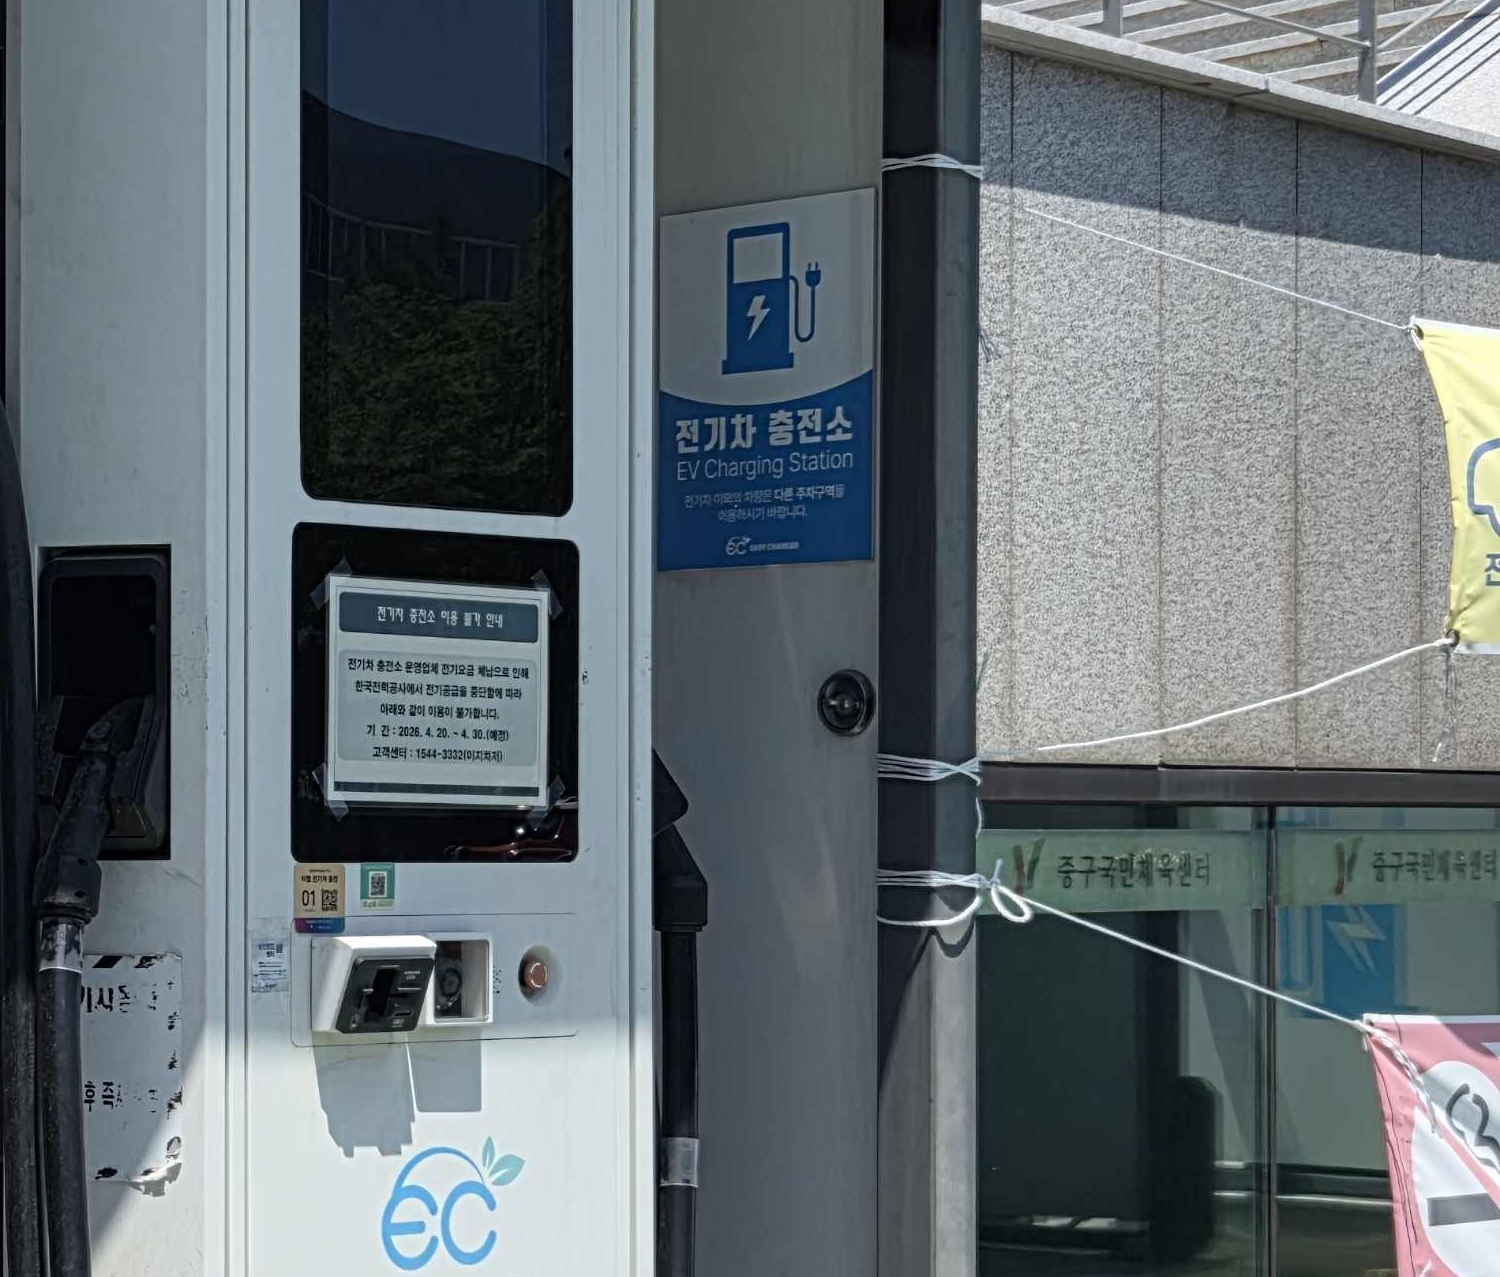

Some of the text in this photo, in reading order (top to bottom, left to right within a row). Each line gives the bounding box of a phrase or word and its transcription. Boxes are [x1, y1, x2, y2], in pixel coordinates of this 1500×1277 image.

[675, 405, 853, 454] 전기차 충전소
[676, 450, 854, 482] EV Charging Station
[377, 606, 404, 623] 전기차
[409, 608, 436, 624] 충전소
[441, 609, 458, 627] 이용
[486, 612, 503, 629] 안내
[348, 658, 375, 672] 전기차
[377, 659, 403, 673] 충전소
[441, 662, 475, 677] 전기요금
[512, 666, 530, 680] 인해
[355, 680, 424, 696] 한국전력공사에서
[426, 683, 467, 698] 전기공급을
[505, 688, 522, 701] 따라
[380, 703, 406, 717] 아래와
[409, 704, 426, 718] 같이
[428, 705, 454, 719] 이용이
[398, 726, 423, 738] 2026.
[372, 746, 407, 761] 고객센터
[1057, 850, 1212, 889] 중구국민체육센터
[302, 889, 315, 907] 01
